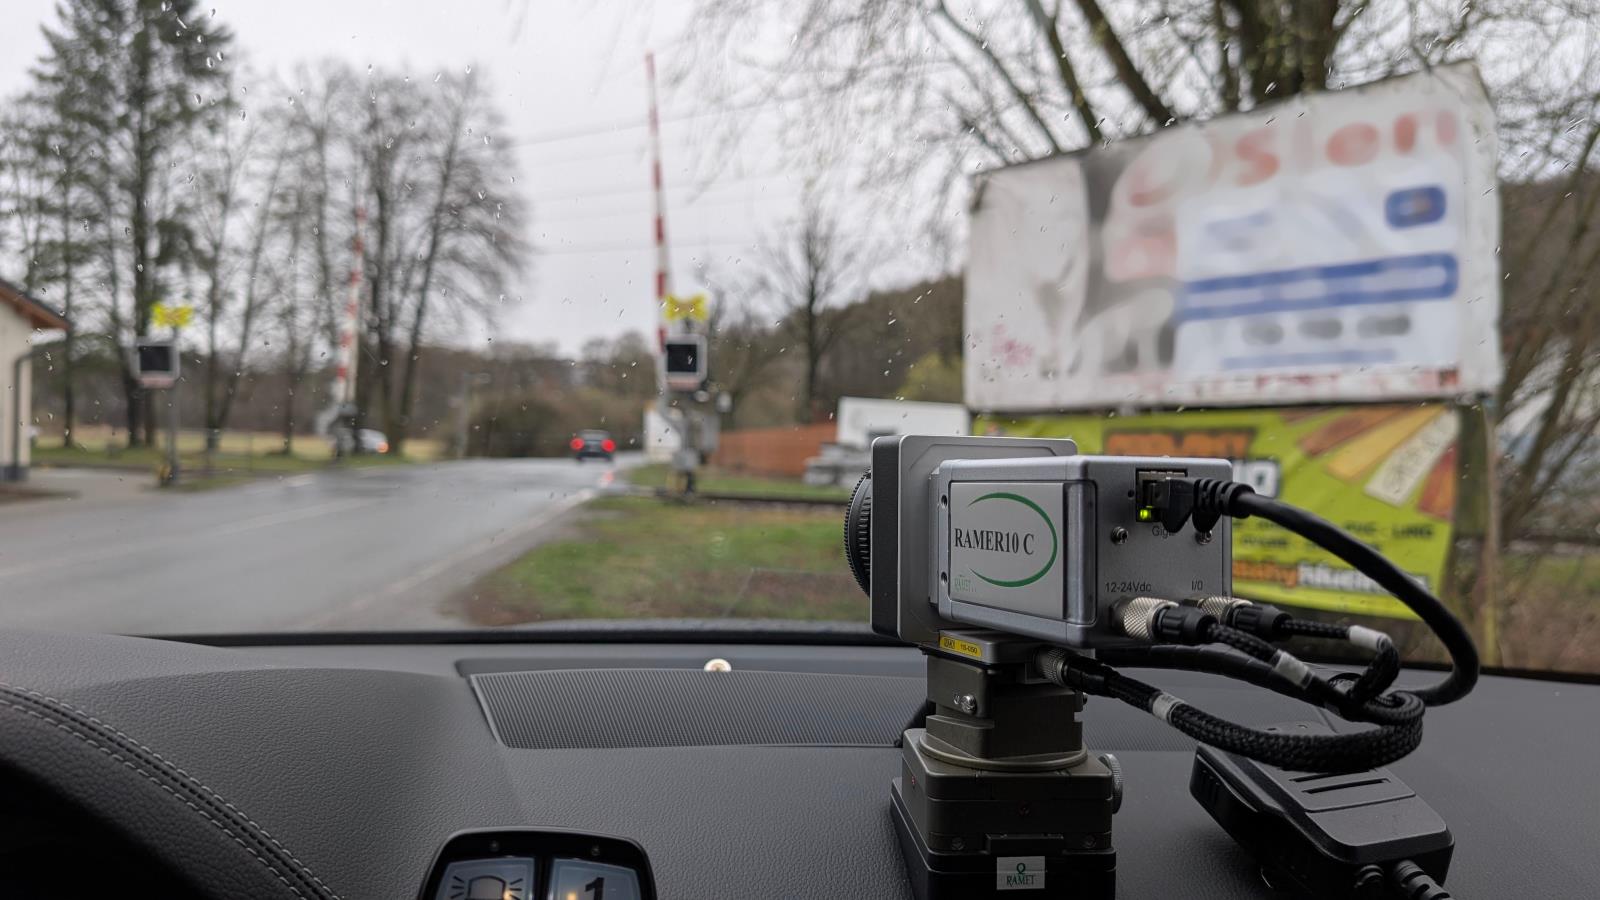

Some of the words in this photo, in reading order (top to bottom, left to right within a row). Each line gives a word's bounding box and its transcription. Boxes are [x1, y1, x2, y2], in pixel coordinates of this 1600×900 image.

[955, 528, 1019, 554] RAMER10
[1023, 533, 1034, 555] C
[1152, 525, 1175, 539] Gig
